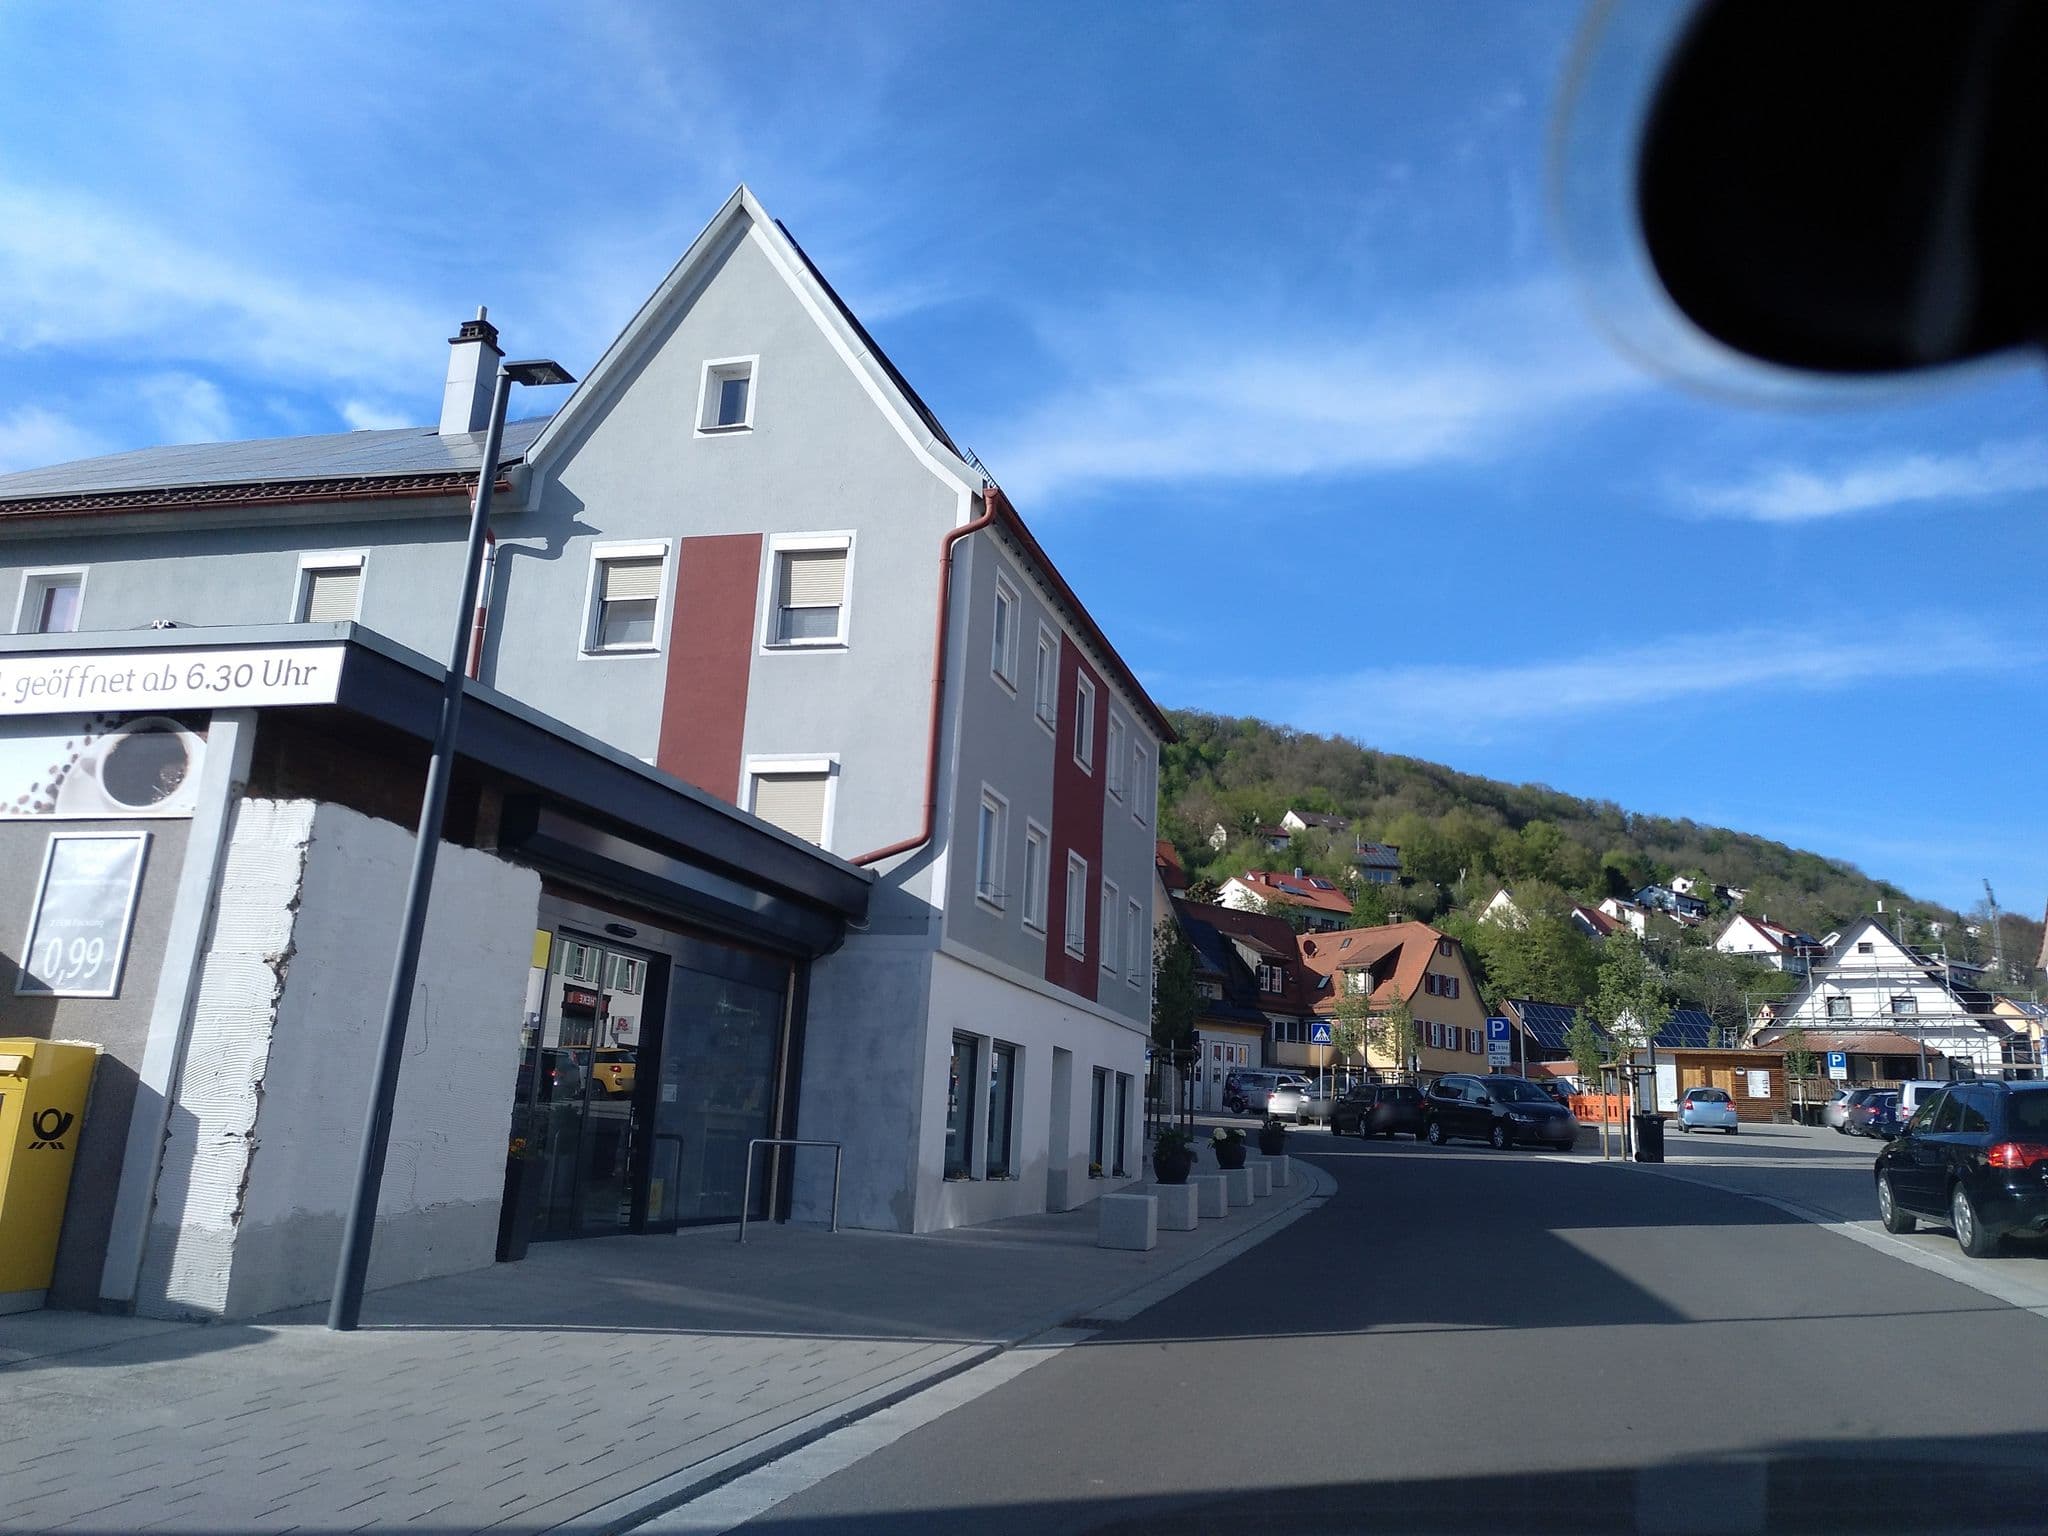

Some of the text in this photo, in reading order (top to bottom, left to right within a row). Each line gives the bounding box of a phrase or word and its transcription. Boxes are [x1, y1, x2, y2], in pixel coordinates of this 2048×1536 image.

[14, 664, 137, 704] geöffnet
[142, 664, 178, 692] ab
[186, 661, 255, 693] 6.30
[262, 657, 318, 688] Uhr
[43, 937, 104, 984] 0,99
[1492, 1021, 1505, 1038] P
[1832, 1054, 1842, 1066] P
